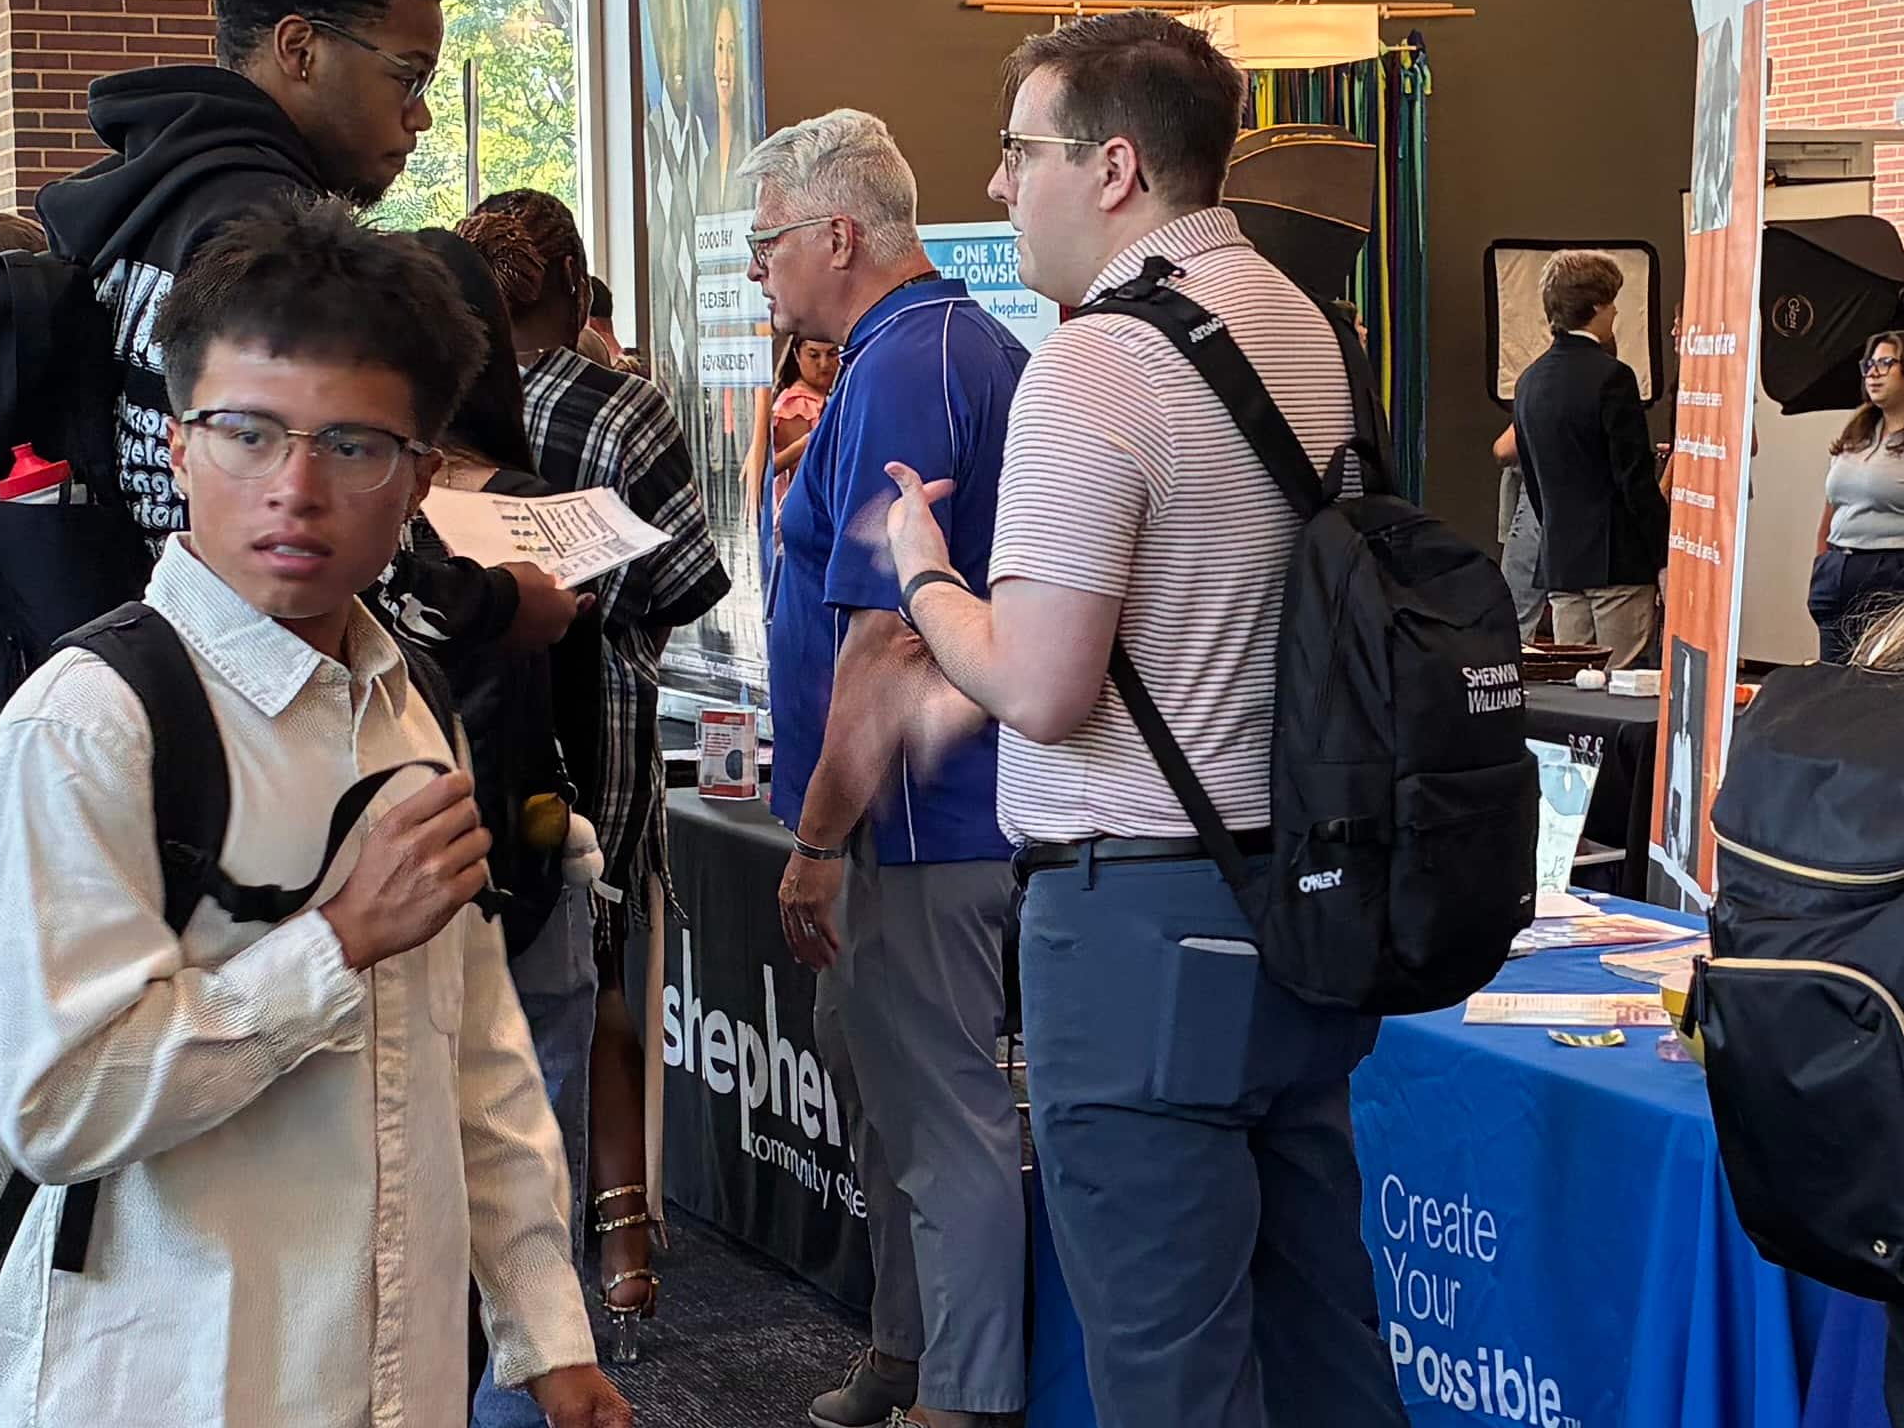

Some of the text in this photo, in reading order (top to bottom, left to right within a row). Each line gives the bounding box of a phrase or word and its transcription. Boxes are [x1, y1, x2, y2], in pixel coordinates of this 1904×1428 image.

[953, 243, 1021, 265] ONE YEA
[1462, 663, 1519, 687] SHERWIN
[1380, 1174, 1497, 1263] Create
[1383, 1246, 1461, 1330] Your
